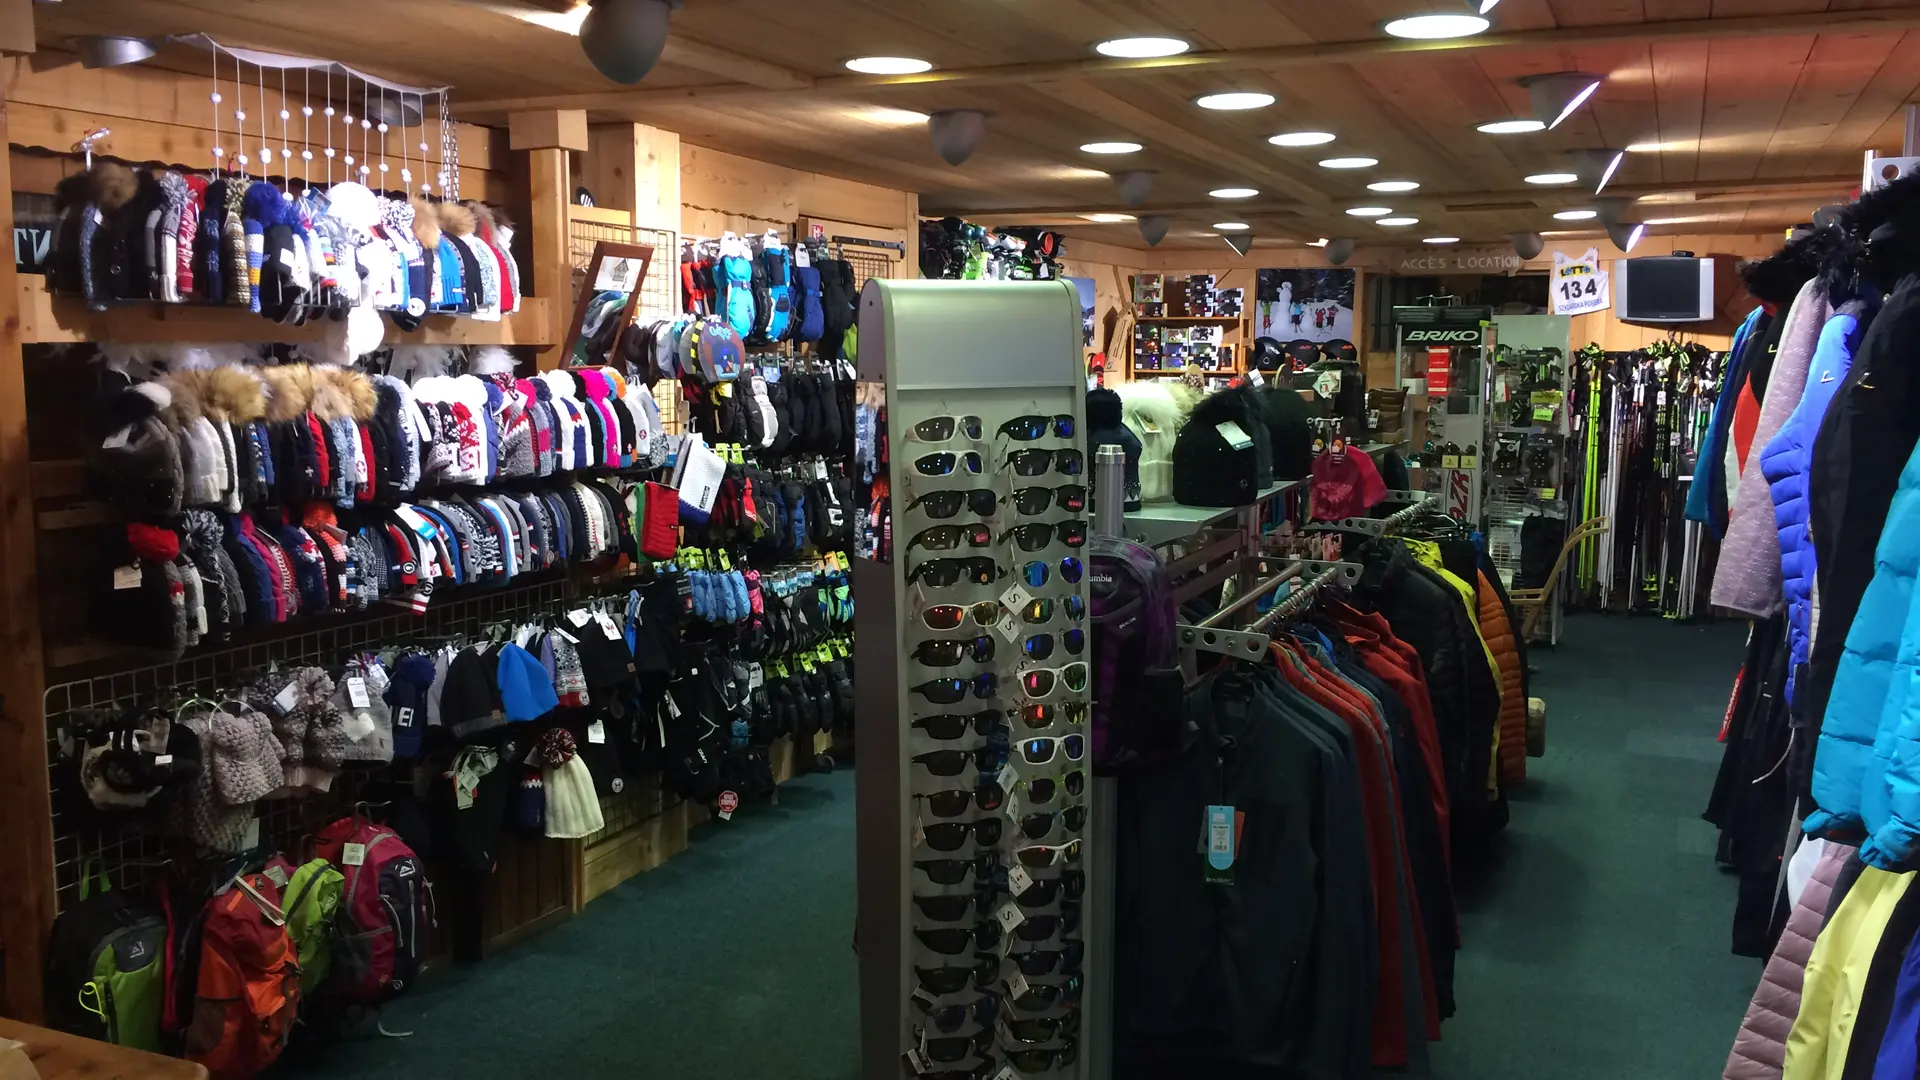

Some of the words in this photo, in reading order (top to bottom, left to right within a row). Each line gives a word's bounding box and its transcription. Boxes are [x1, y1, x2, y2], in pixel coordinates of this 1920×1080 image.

[1457, 254, 1520, 269] LOCATION
[1560, 265, 1591, 277] LOTTO
[1560, 278, 1597, 300] 134
[1405, 330, 1479, 341] BRIKO
[1089, 573, 1113, 583] umbia
